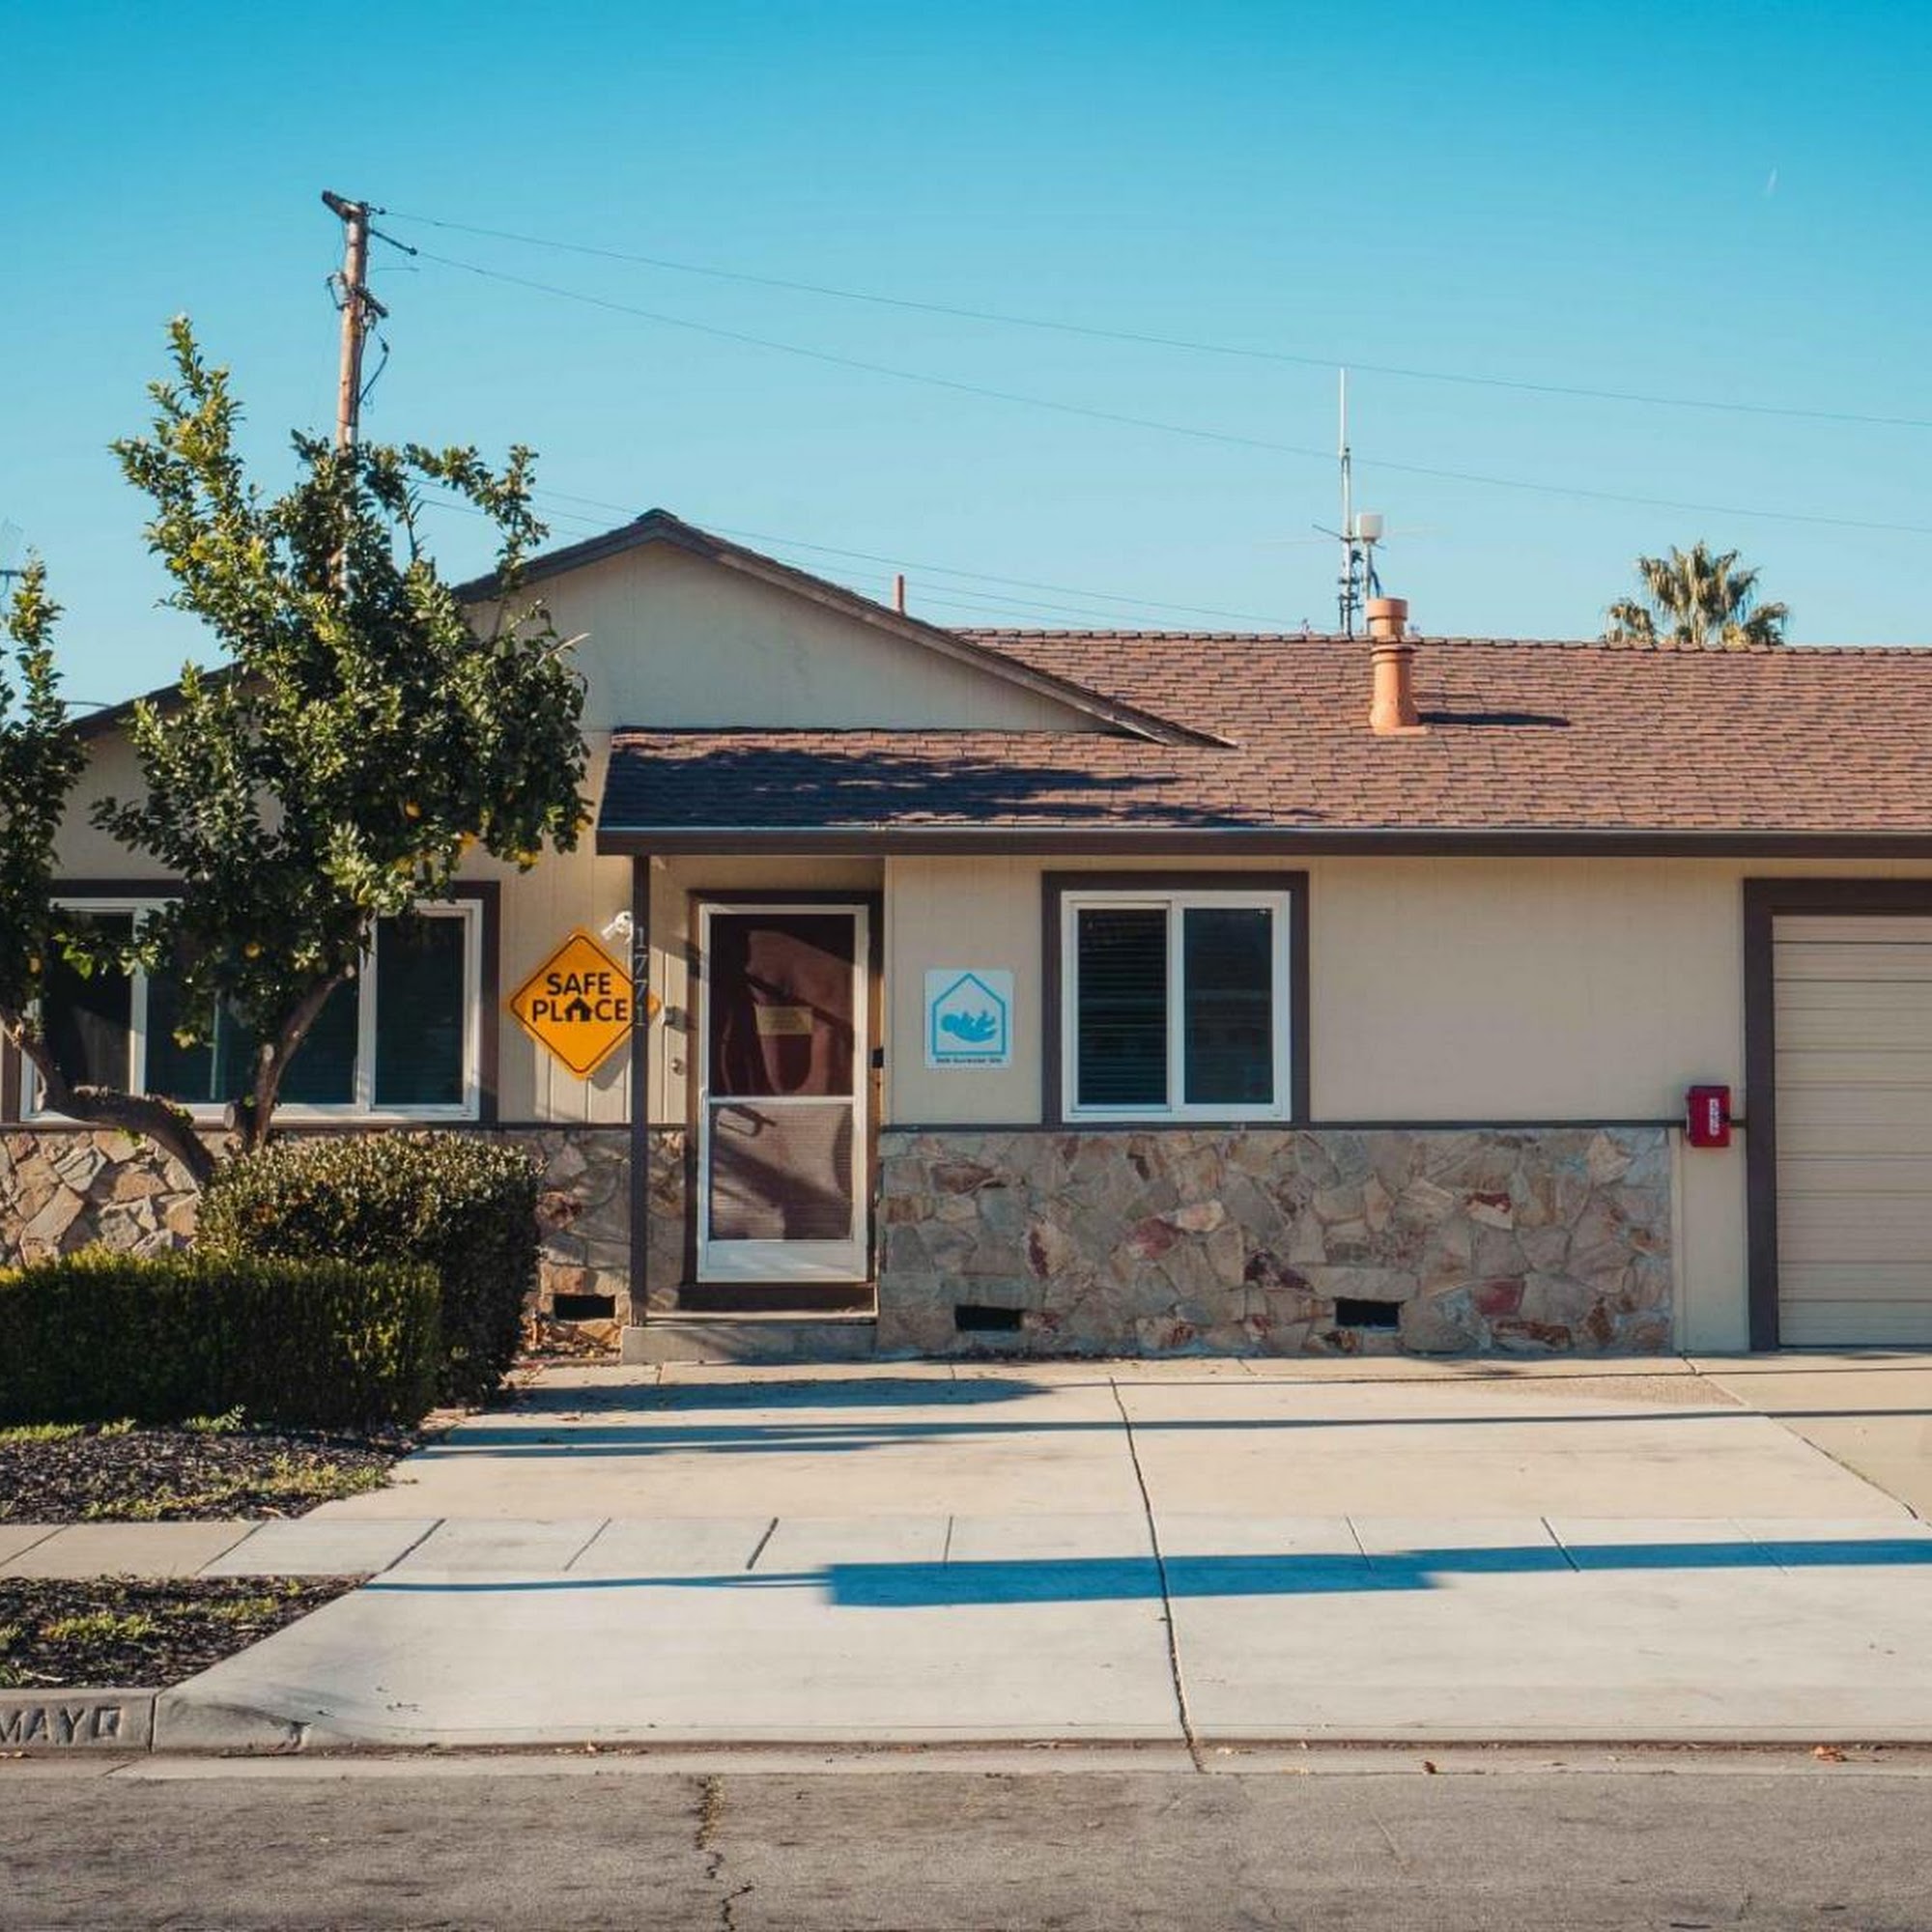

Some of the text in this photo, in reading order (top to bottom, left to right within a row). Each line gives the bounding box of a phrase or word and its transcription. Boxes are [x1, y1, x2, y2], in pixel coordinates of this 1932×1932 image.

[547, 972, 611, 996] SAFE
[634, 926, 649, 1026] 1771
[532, 998, 628, 1023] PLACE
